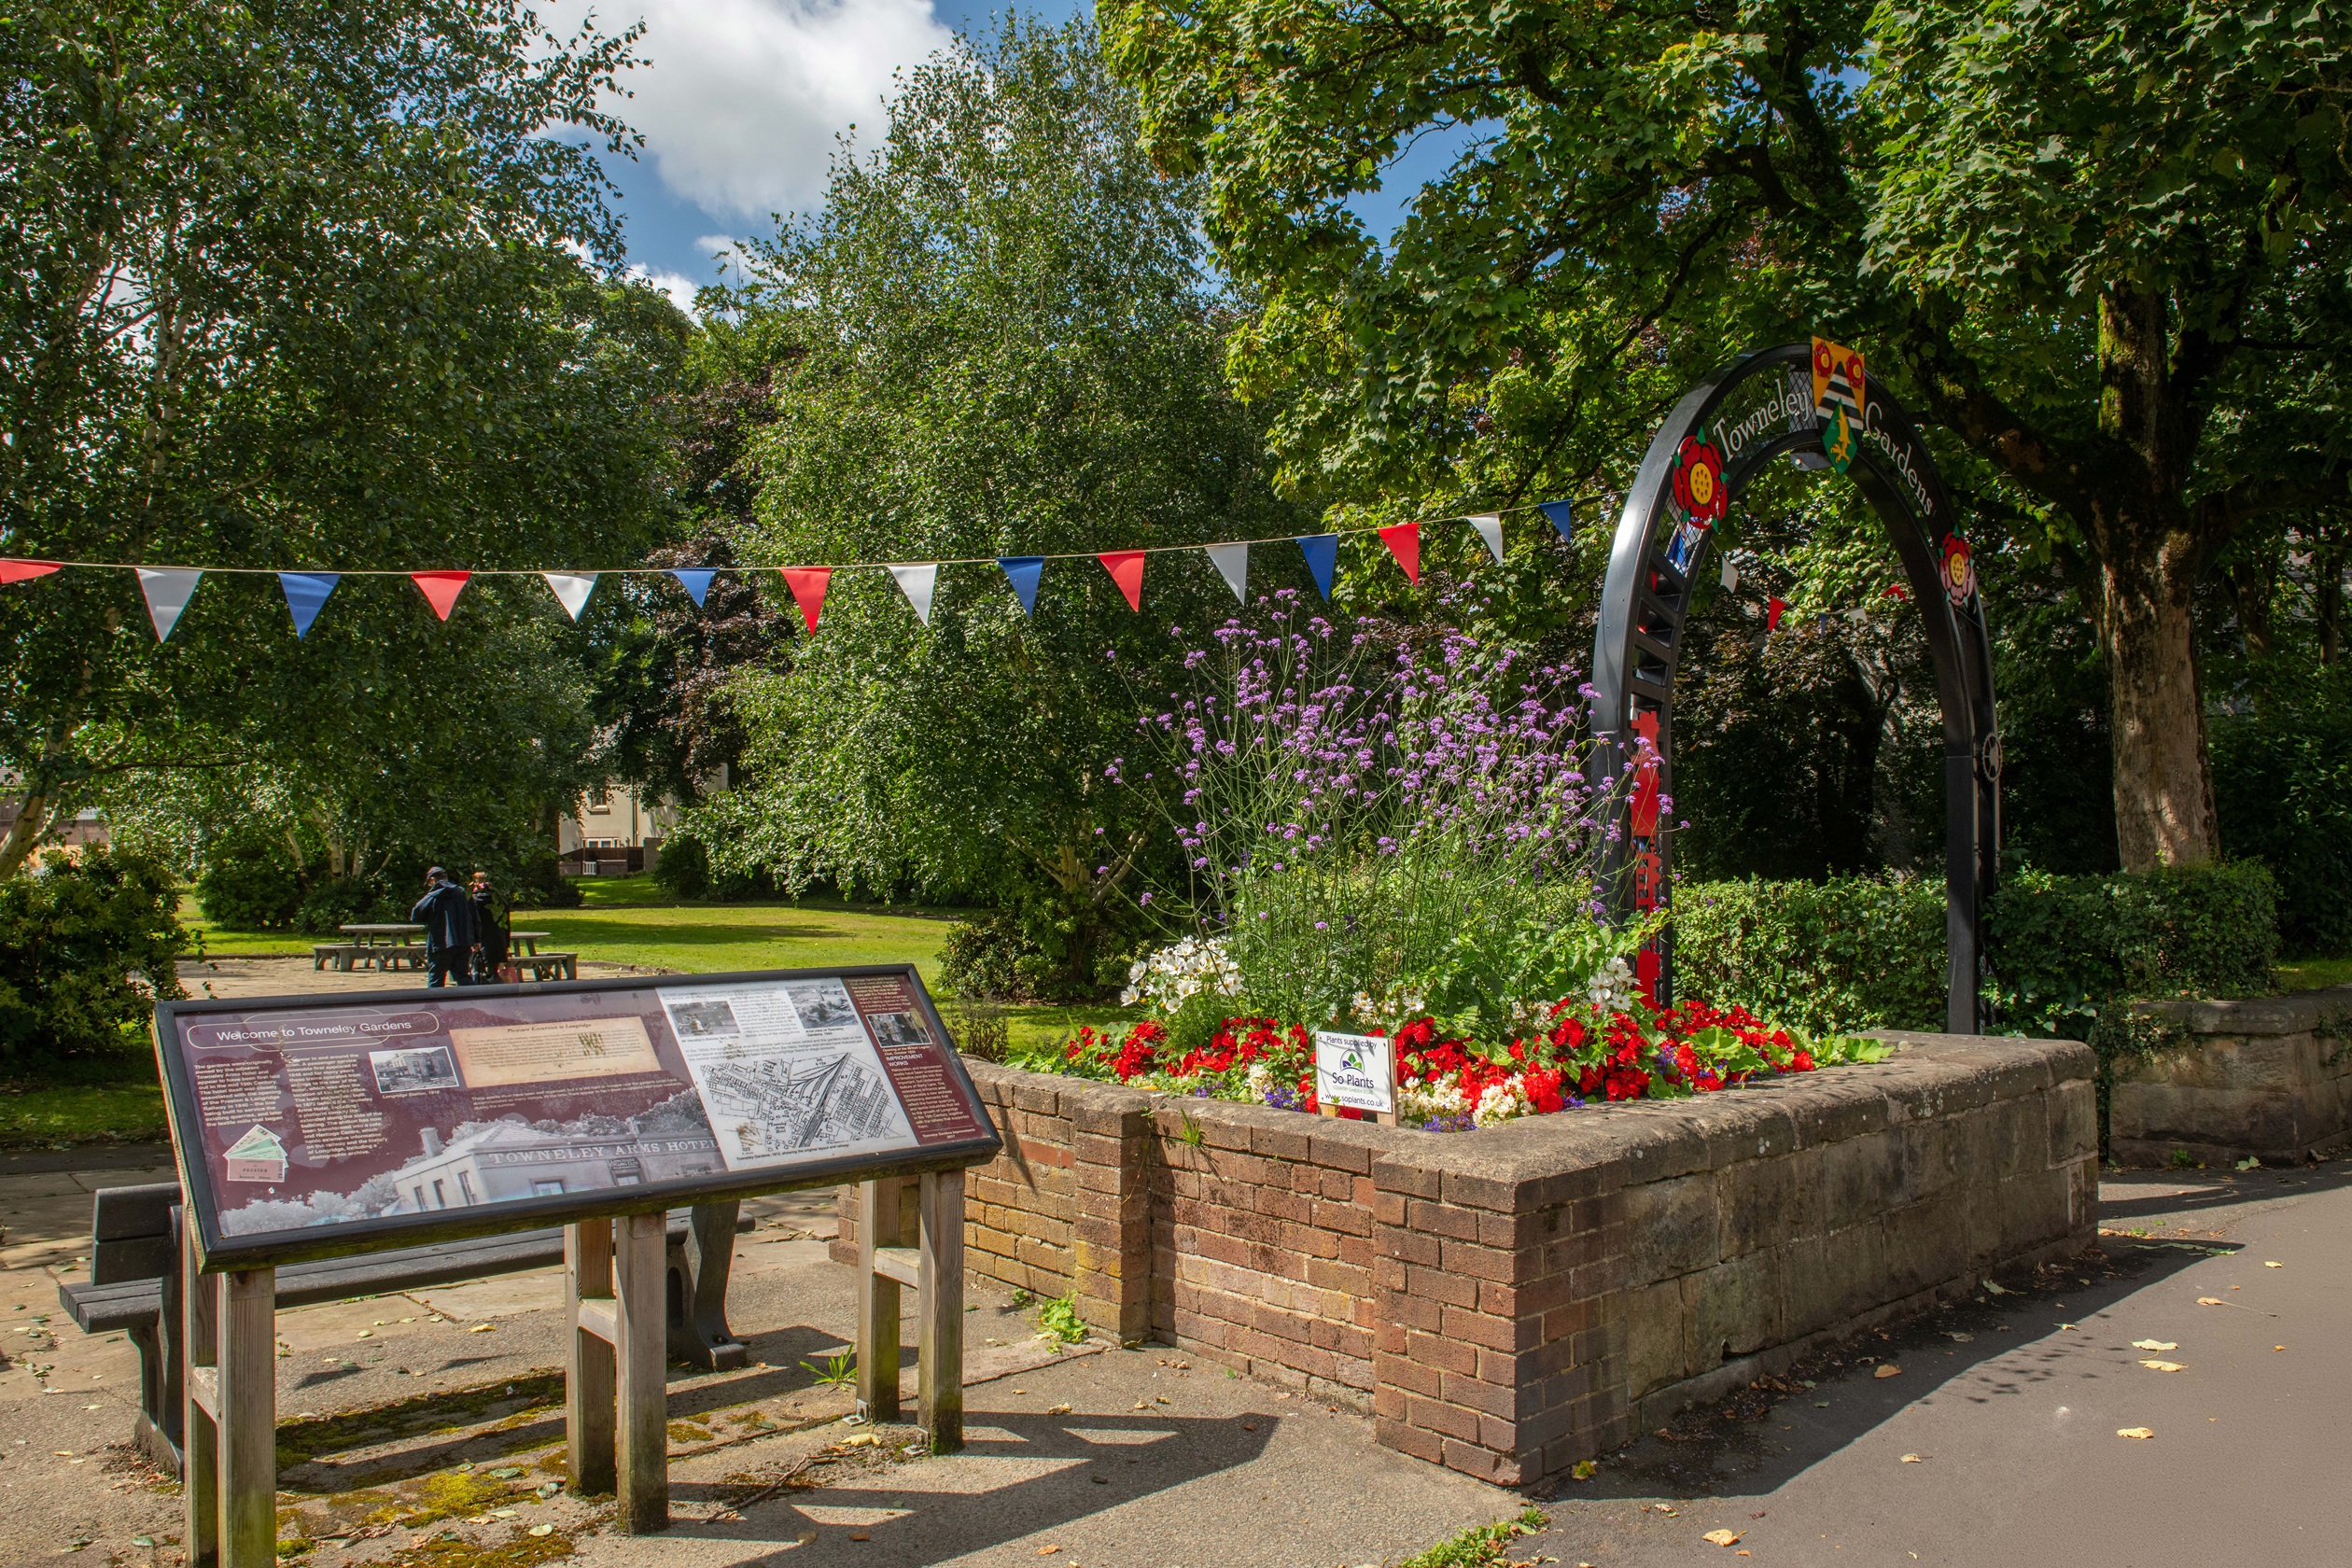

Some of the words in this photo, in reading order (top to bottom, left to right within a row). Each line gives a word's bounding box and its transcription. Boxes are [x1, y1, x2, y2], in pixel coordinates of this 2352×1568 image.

[1713, 379, 1811, 463] Towneley
[1866, 401, 1934, 516] Gardens
[217, 1029, 278, 1041] Welcome
[282, 1028, 295, 1037] to
[298, 1024, 357, 1036] Towneley
[360, 1021, 412, 1032] Gardens
[1326, 1035, 1343, 1044] Plants
[1332, 1072, 1345, 1085] So
[1347, 1074, 1375, 1089] Plants
[488, 1146, 604, 1165] TOWNELEY
[614, 1141, 660, 1155] ARMS
[665, 1139, 718, 1152] HOTEL
